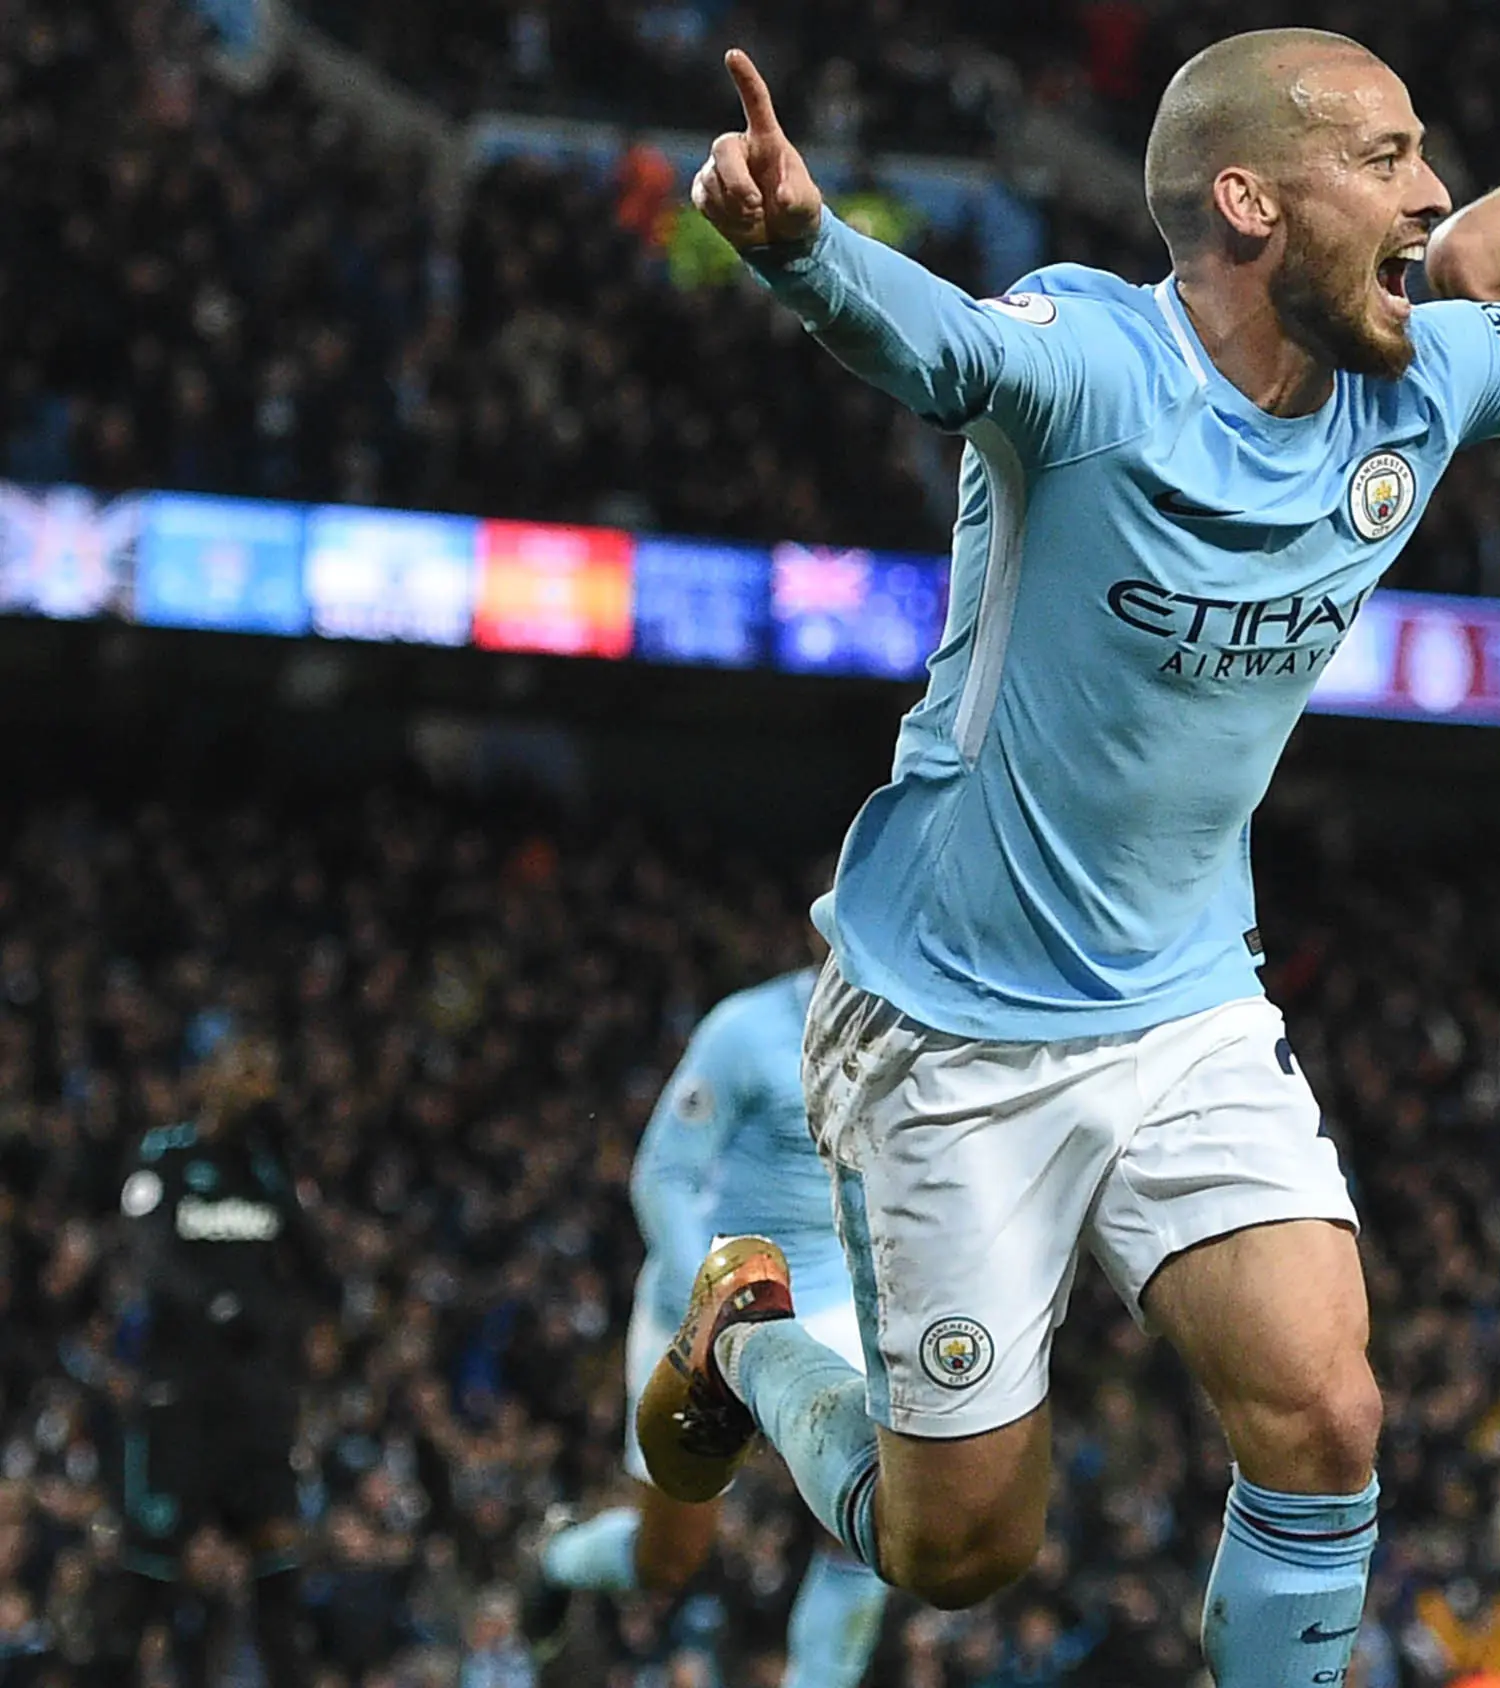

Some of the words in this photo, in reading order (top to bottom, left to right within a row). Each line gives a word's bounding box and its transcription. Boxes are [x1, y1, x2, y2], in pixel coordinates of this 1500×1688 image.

[1355, 457, 1409, 491] MANCHESTER
[1372, 525, 1390, 536] CITY
[926, 1322, 985, 1346] MANCHESTER
